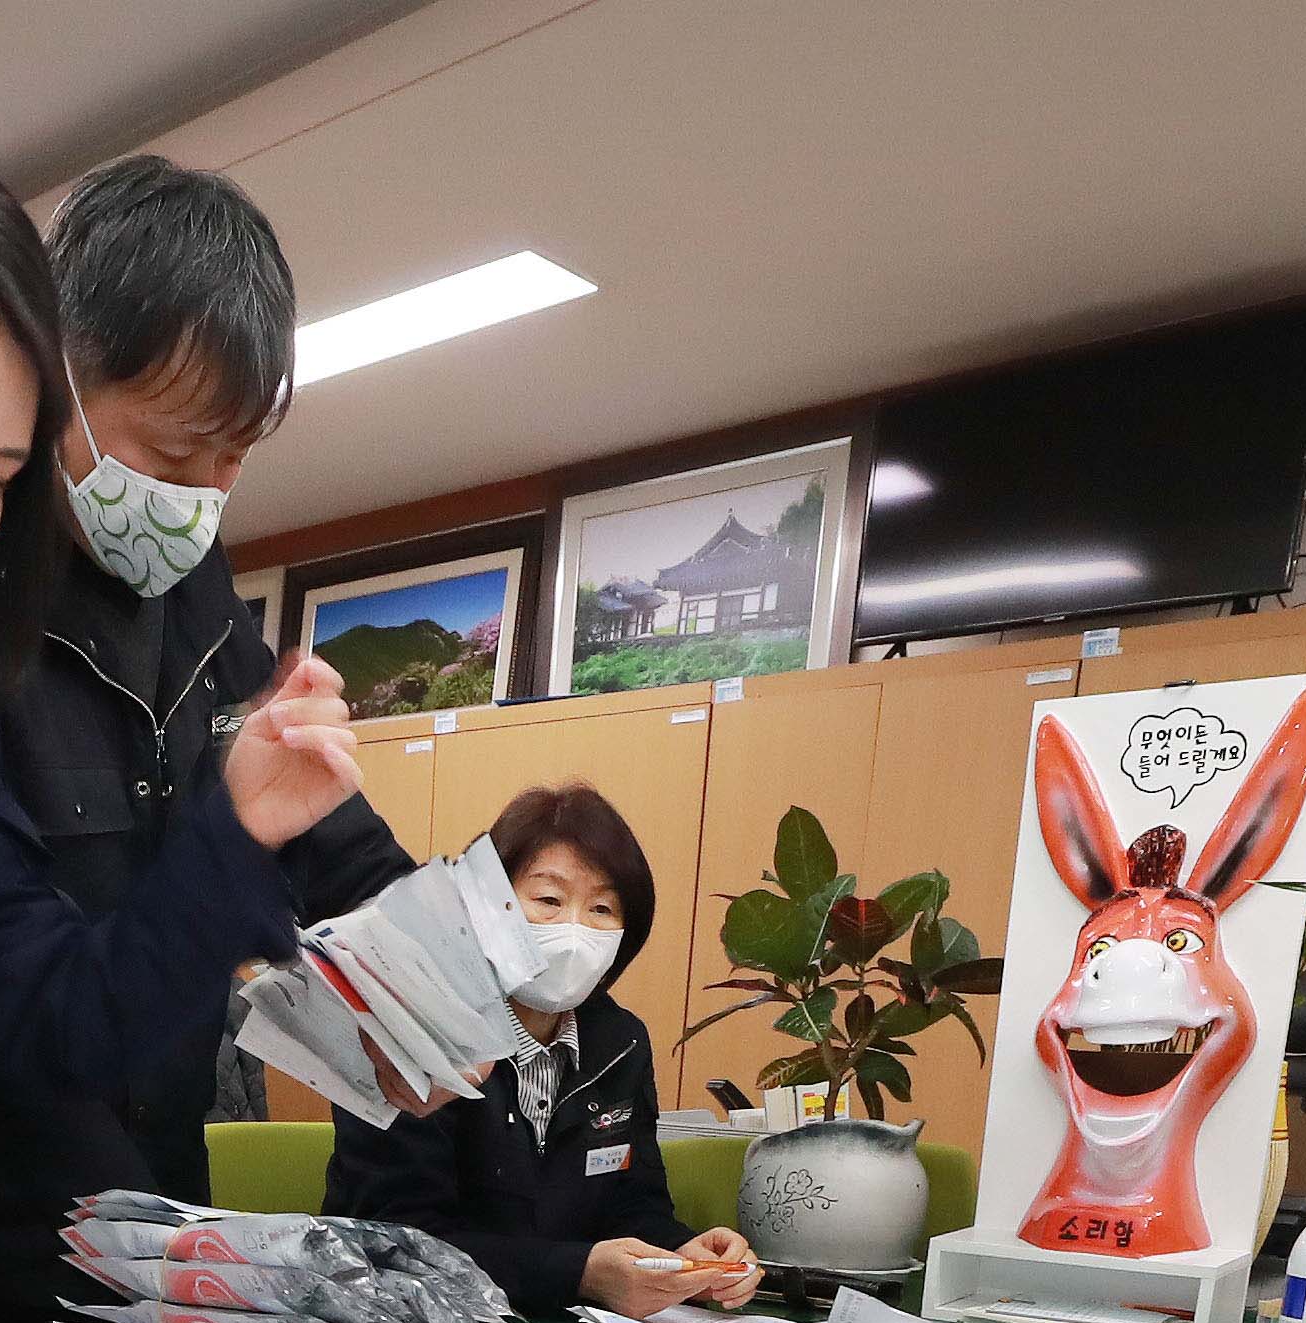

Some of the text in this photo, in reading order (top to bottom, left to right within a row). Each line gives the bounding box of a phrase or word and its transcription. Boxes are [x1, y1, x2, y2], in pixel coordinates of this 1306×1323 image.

[1140, 723, 1211, 750] 무엇이든
[1138, 743, 1241, 780] 들어 드릴게요
[1057, 1214, 1135, 1248] 소리함
